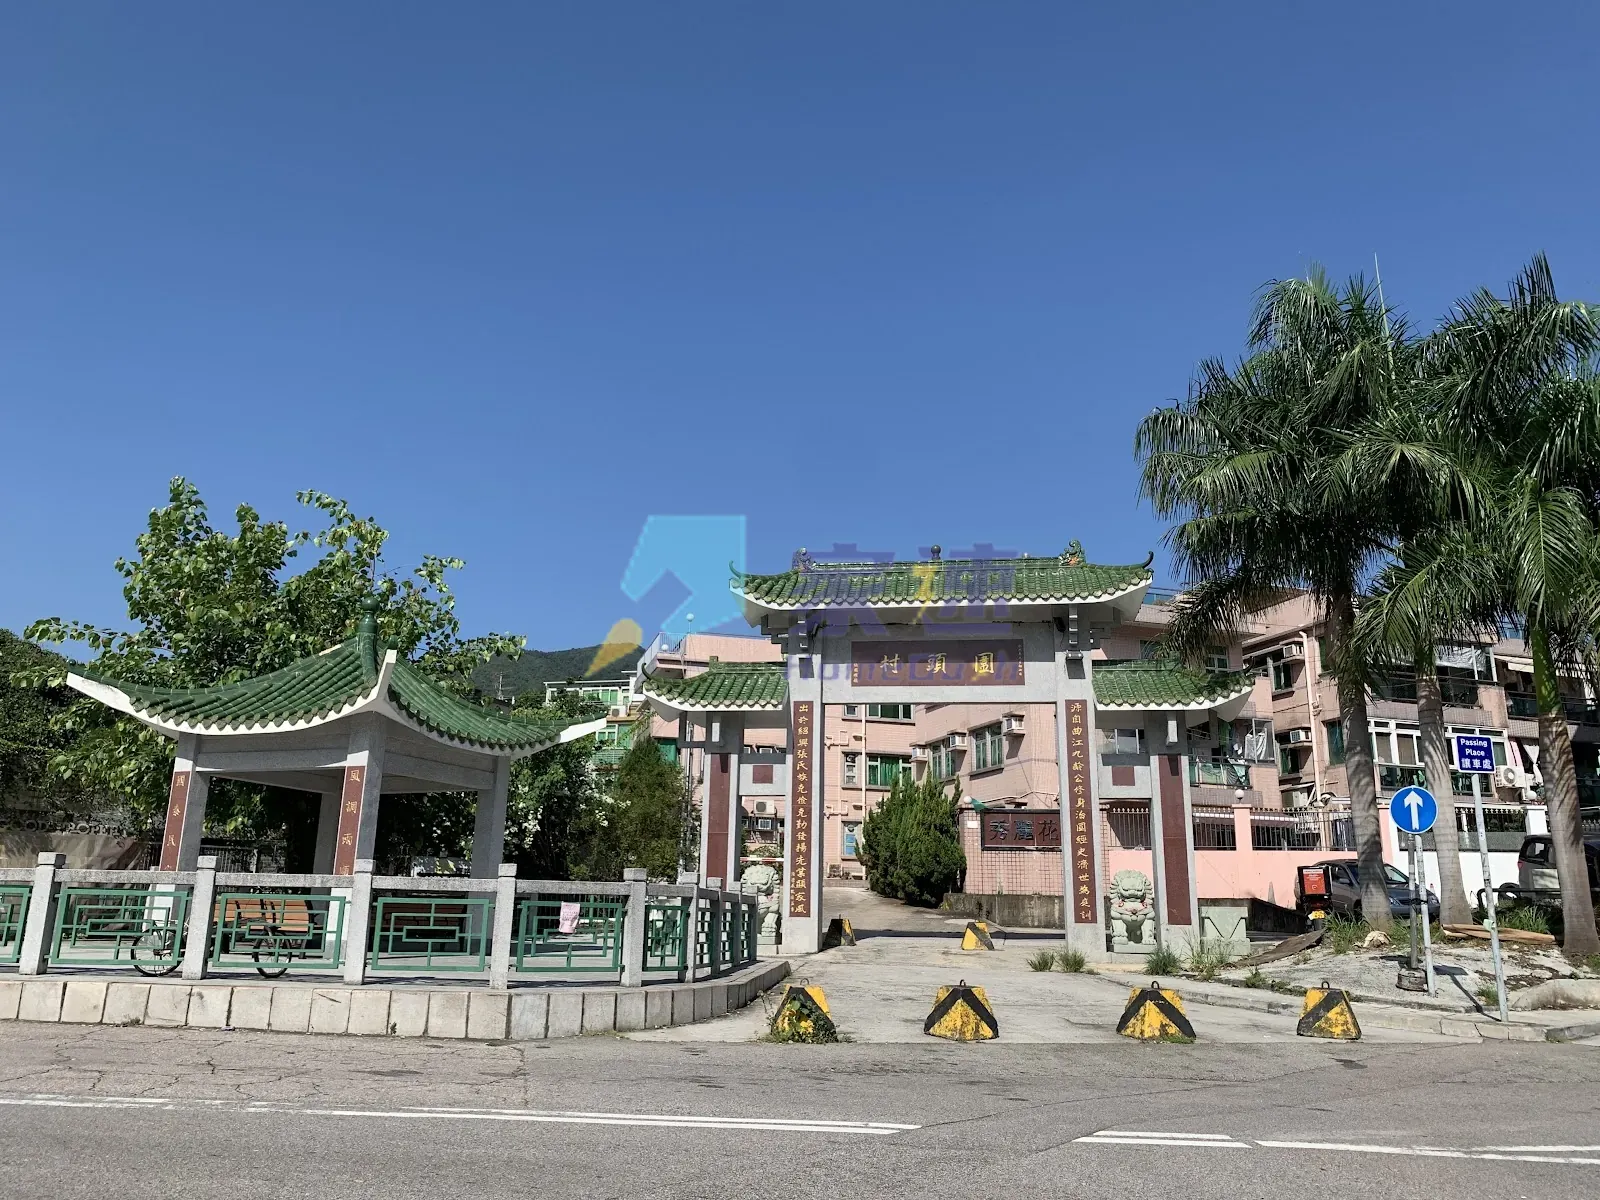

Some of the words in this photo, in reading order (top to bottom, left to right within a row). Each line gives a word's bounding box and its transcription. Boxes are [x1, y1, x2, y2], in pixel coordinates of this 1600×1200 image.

[1460, 738, 1488, 748] Passing
[1465, 748, 1485, 756] Place
[164, 774, 186, 870] 國泰民
